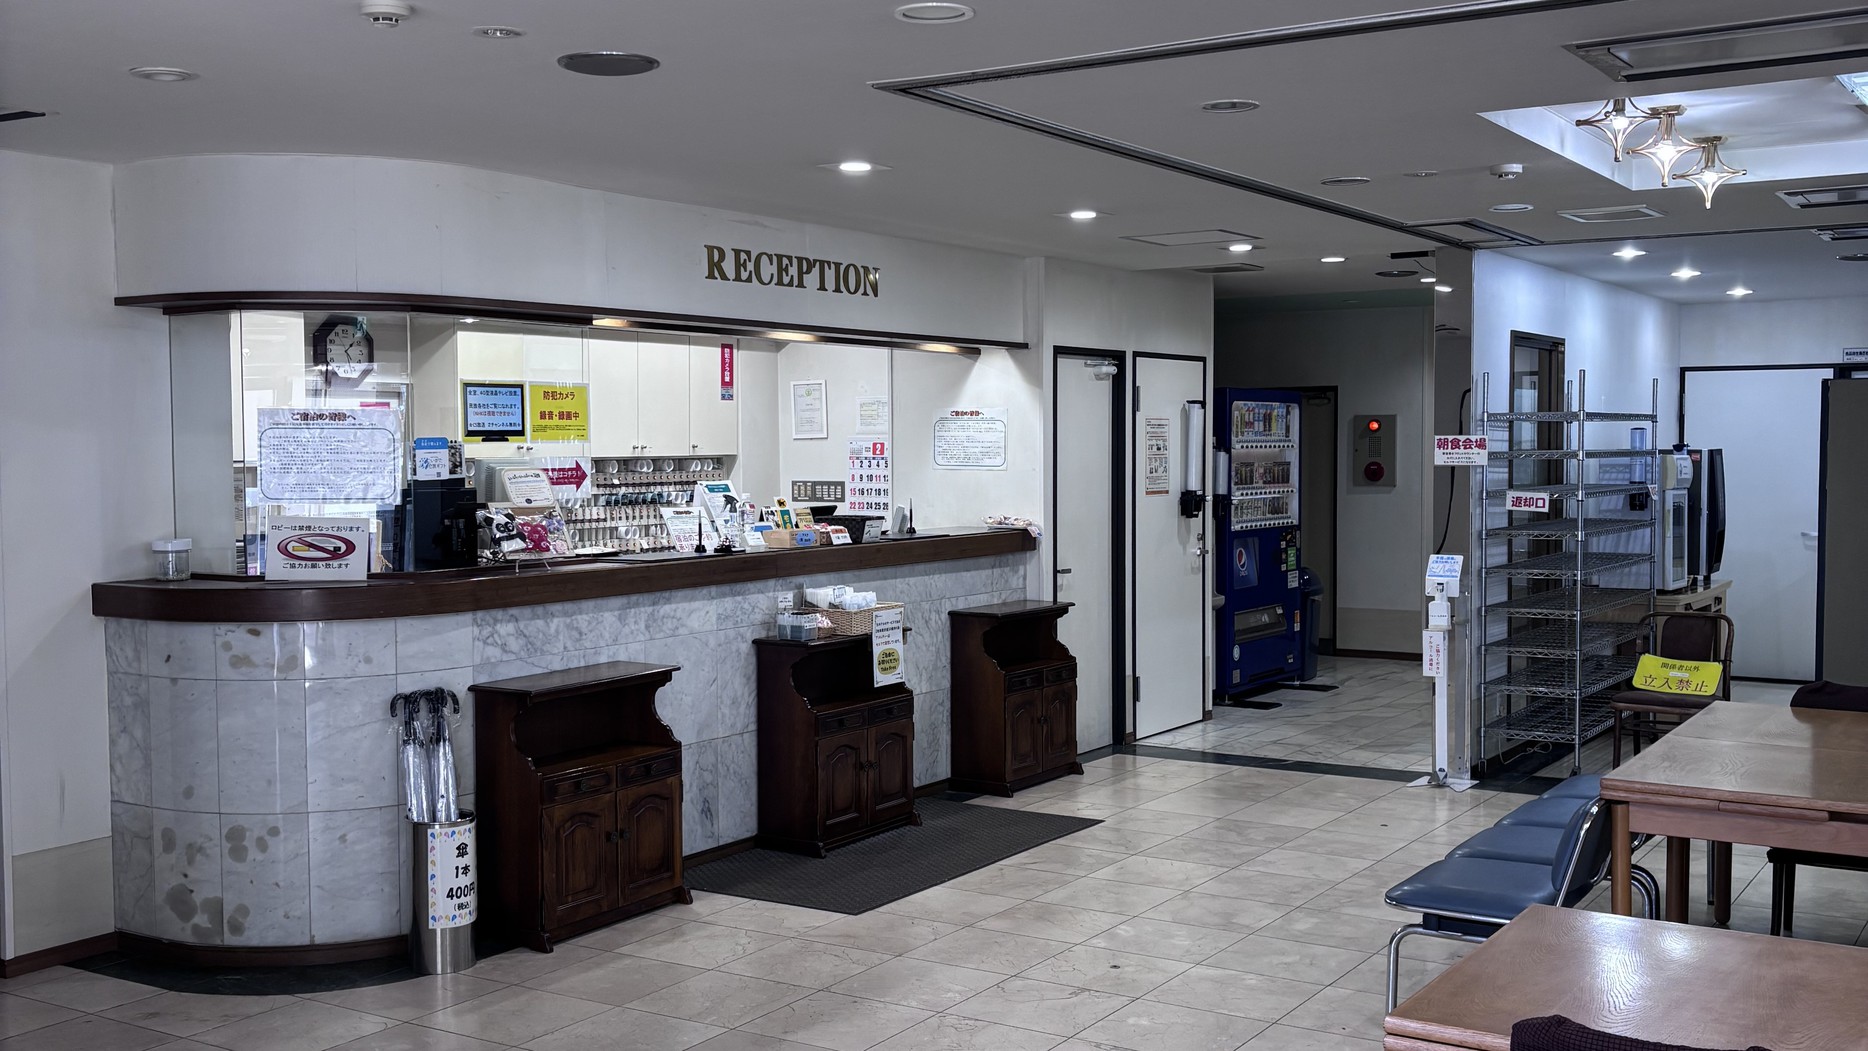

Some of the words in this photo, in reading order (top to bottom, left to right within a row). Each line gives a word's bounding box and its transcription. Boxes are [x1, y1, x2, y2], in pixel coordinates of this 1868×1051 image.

[704, 244, 880, 298] RECEPTION
[543, 390, 575, 400] 防犯カメラ
[540, 410, 580, 420] 録音・録画中
[876, 444, 881, 454] 2
[1436, 438, 1487, 450] 朝食会場
[850, 488, 856, 496] 15
[858, 488, 864, 496] 16
[866, 488, 873, 496] 17
[874, 488, 881, 496] 18
[849, 502, 856, 510] 22
[858, 502, 864, 510] 23
[866, 502, 873, 510] 24
[874, 502, 881, 510] 25
[1511, 496, 1546, 508] 返却口
[271, 524, 365, 533] ロビーは禁煙となっております。
[1661, 662, 1700, 672] 関係者以外
[1640, 674, 1708, 693] 立入禁止
[456, 842, 468, 858] 傘
[455, 864, 470, 878] 1本
[446, 881, 475, 900] 400円
